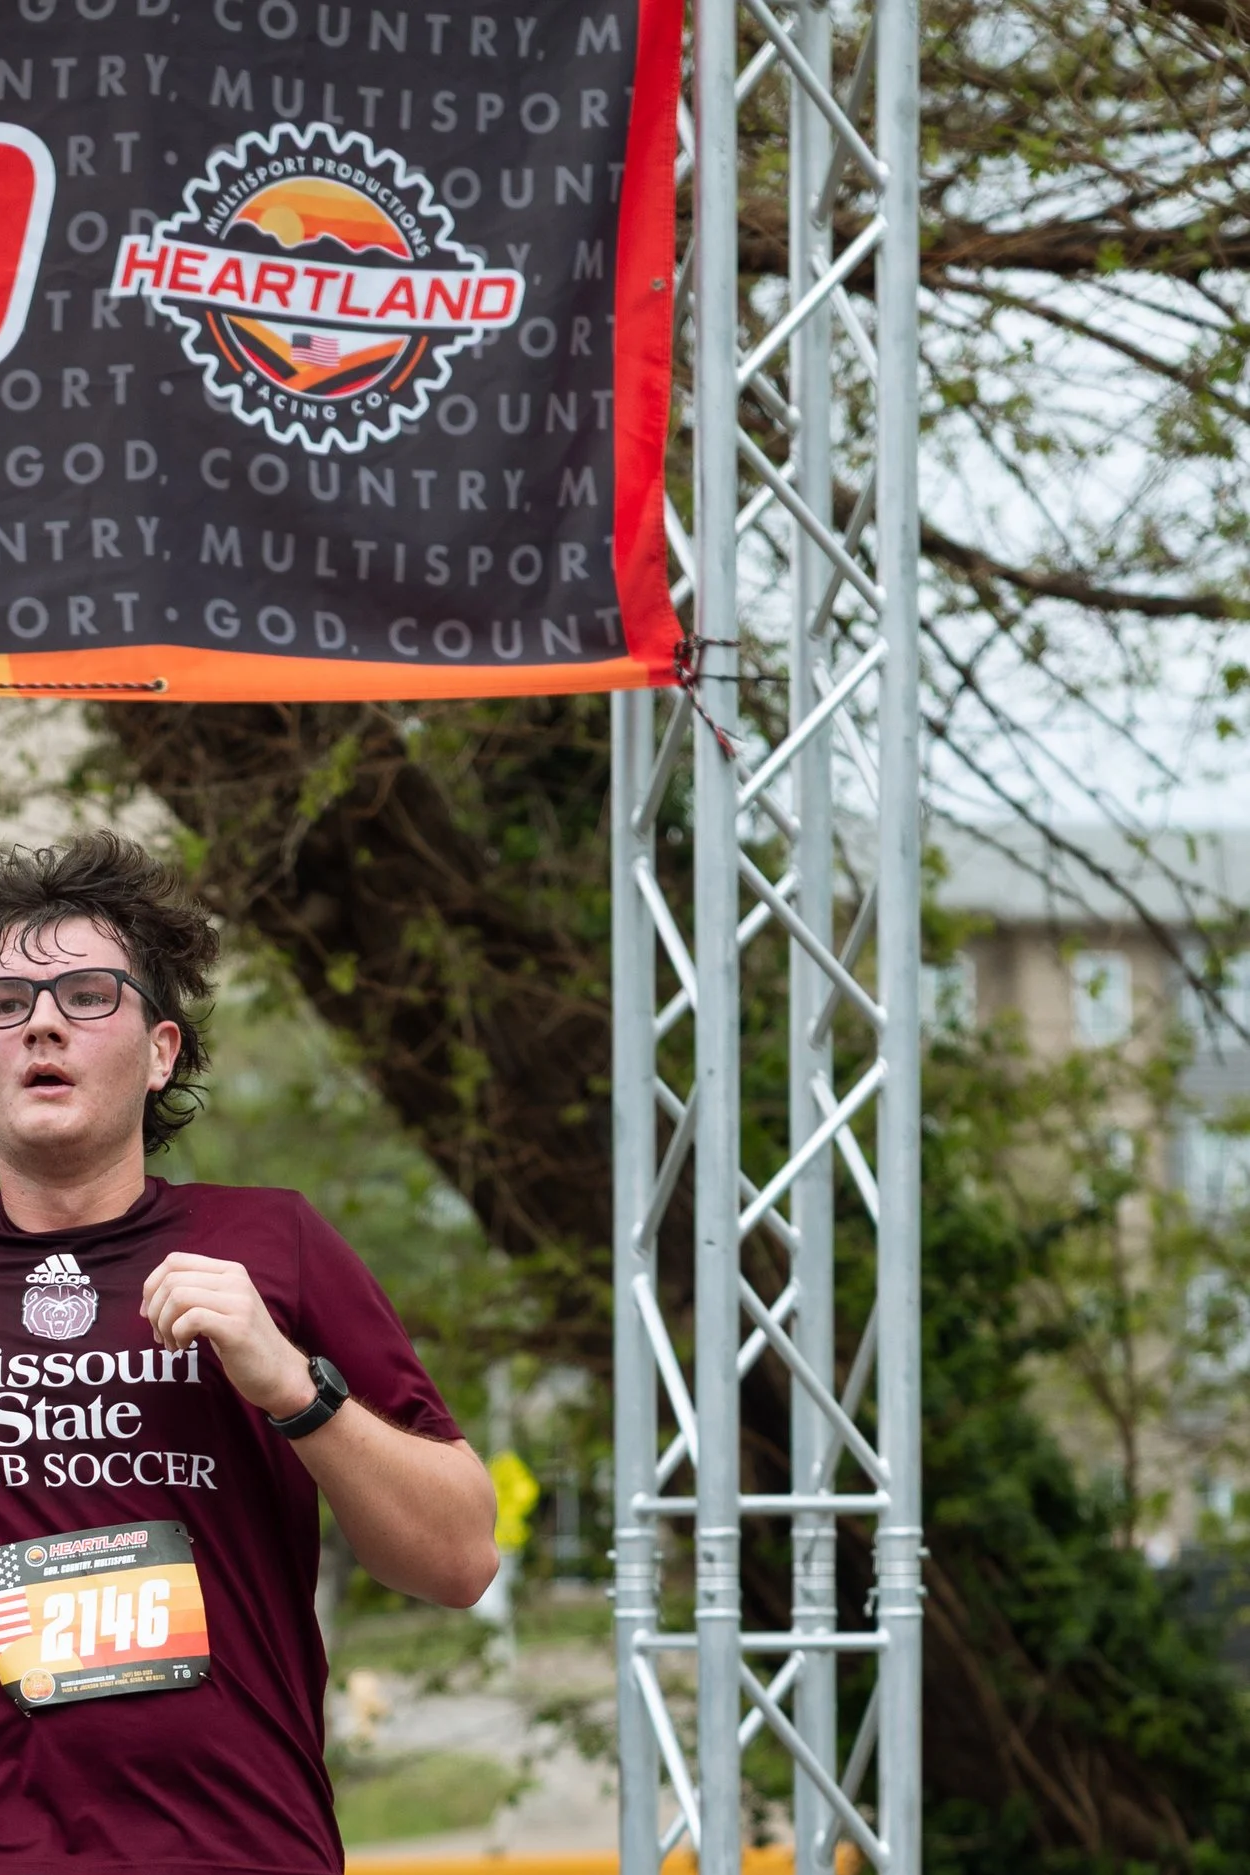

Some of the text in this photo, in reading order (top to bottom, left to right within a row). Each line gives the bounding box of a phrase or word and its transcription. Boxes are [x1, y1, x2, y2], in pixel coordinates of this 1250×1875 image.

[213, 0, 545, 61] COUNTRY,
[203, 157, 305, 237] MULTISPORT
[313, 156, 431, 259] PRODUCTIONS
[118, 242, 519, 322] HEARTLAND
[242, 371, 338, 421] RACING
[5, 440, 168, 488] GOD,
[200, 447, 531, 512] COUNTRY,
[204, 598, 359, 656] GOD,
[25, 1270, 91, 1285] adidas
[44, 1451, 218, 1490] SOCCER
[49, 1530, 148, 1557] HEARTLAND
[40, 1578, 170, 1662] 2146
